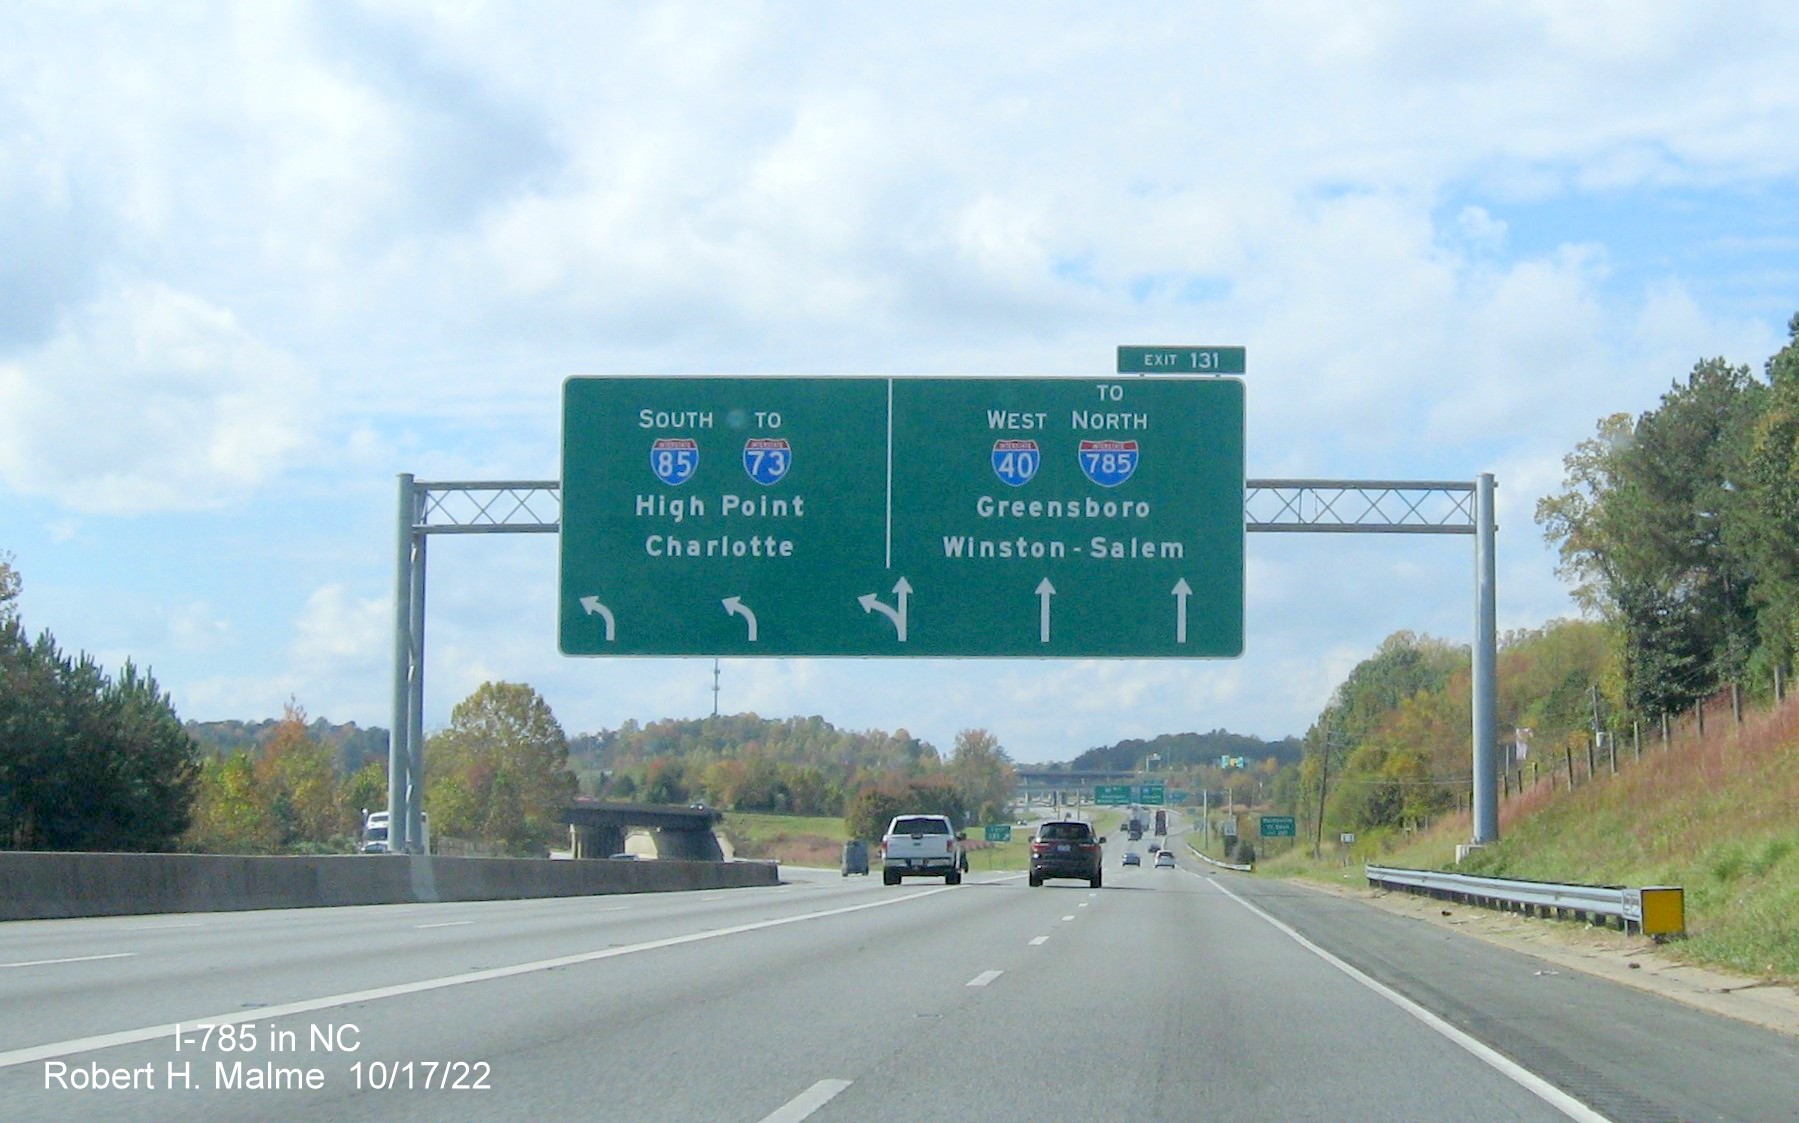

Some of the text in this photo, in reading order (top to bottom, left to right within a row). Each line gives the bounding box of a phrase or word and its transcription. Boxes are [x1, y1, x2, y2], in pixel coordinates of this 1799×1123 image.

[1144, 352, 1219, 369] EXIT 131
[1096, 385, 1124, 401] TO
[639, 409, 782, 429] SOUTH TO
[987, 410, 1148, 430] WEST NORTH
[657, 451, 692, 478] 85
[747, 451, 786, 477] 73
[998, 452, 1034, 478] 40
[1086, 452, 1131, 474] 785
[635, 494, 805, 522] High Point
[976, 496, 1151, 518] Greensboro
[645, 535, 794, 558] Charlotte
